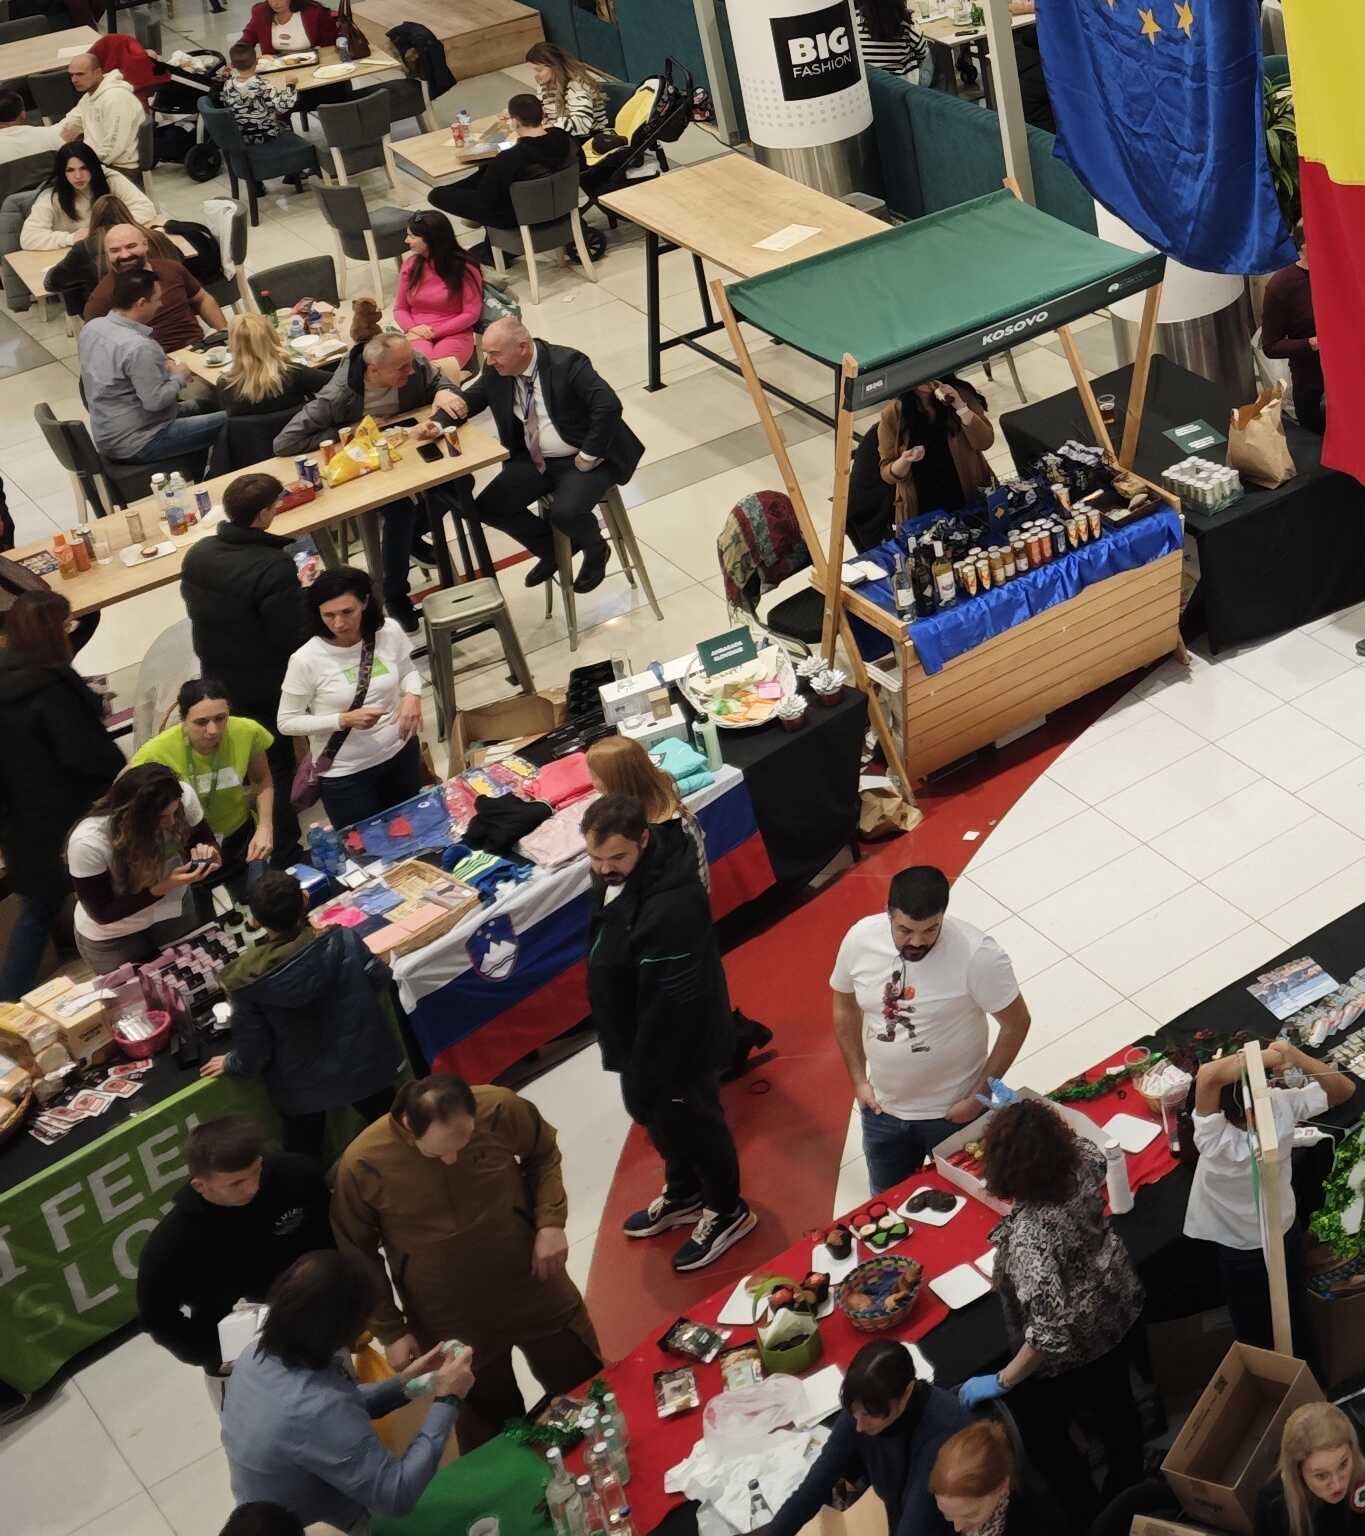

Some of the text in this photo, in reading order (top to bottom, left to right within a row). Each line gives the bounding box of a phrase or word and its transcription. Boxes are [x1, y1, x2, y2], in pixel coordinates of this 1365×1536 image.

[787, 26, 850, 65] BIG
[793, 52, 852, 79] FASHION
[982, 310, 1050, 346] KOSOVO
[40, 1112, 200, 1254] FEE
